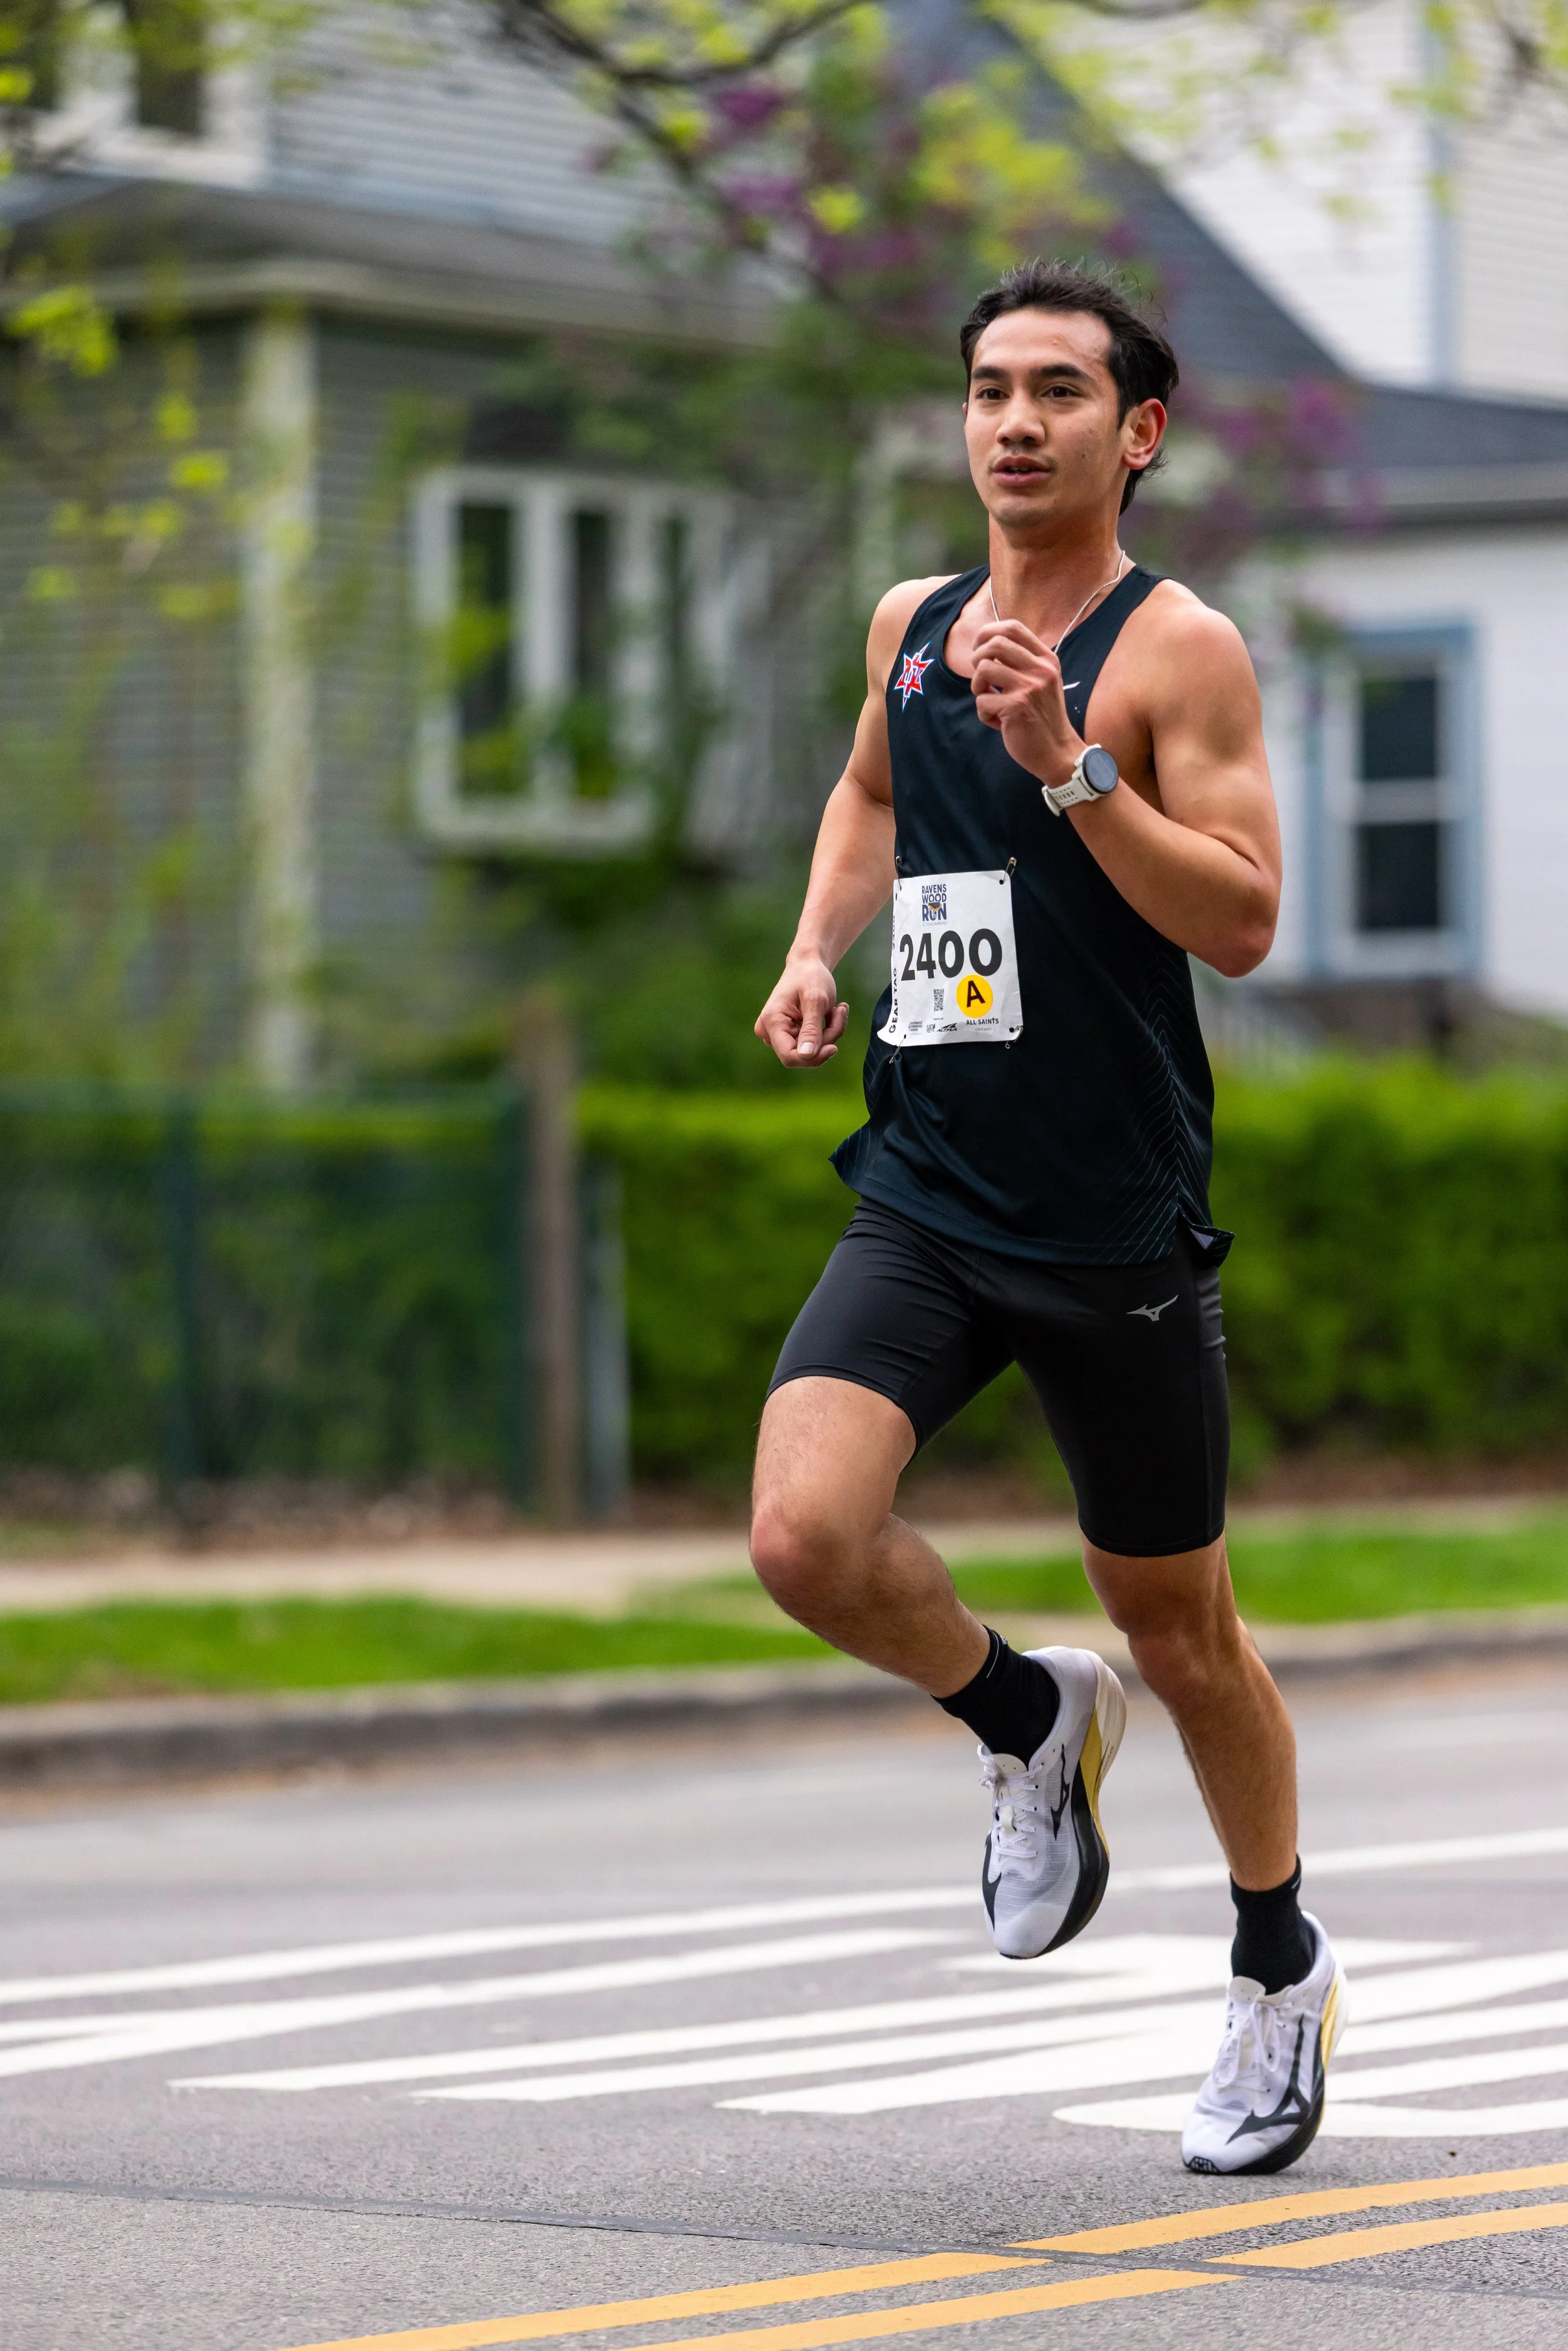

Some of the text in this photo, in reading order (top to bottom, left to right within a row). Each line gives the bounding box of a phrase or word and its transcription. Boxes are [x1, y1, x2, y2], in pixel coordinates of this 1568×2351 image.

[921, 883, 946, 894] RAVENS
[922, 893, 947, 904] WOOD
[922, 903, 947, 921] RUN
[899, 928, 1002, 982] 2400
[966, 980, 986, 1008] A
[889, 997, 898, 1034] GEAR
